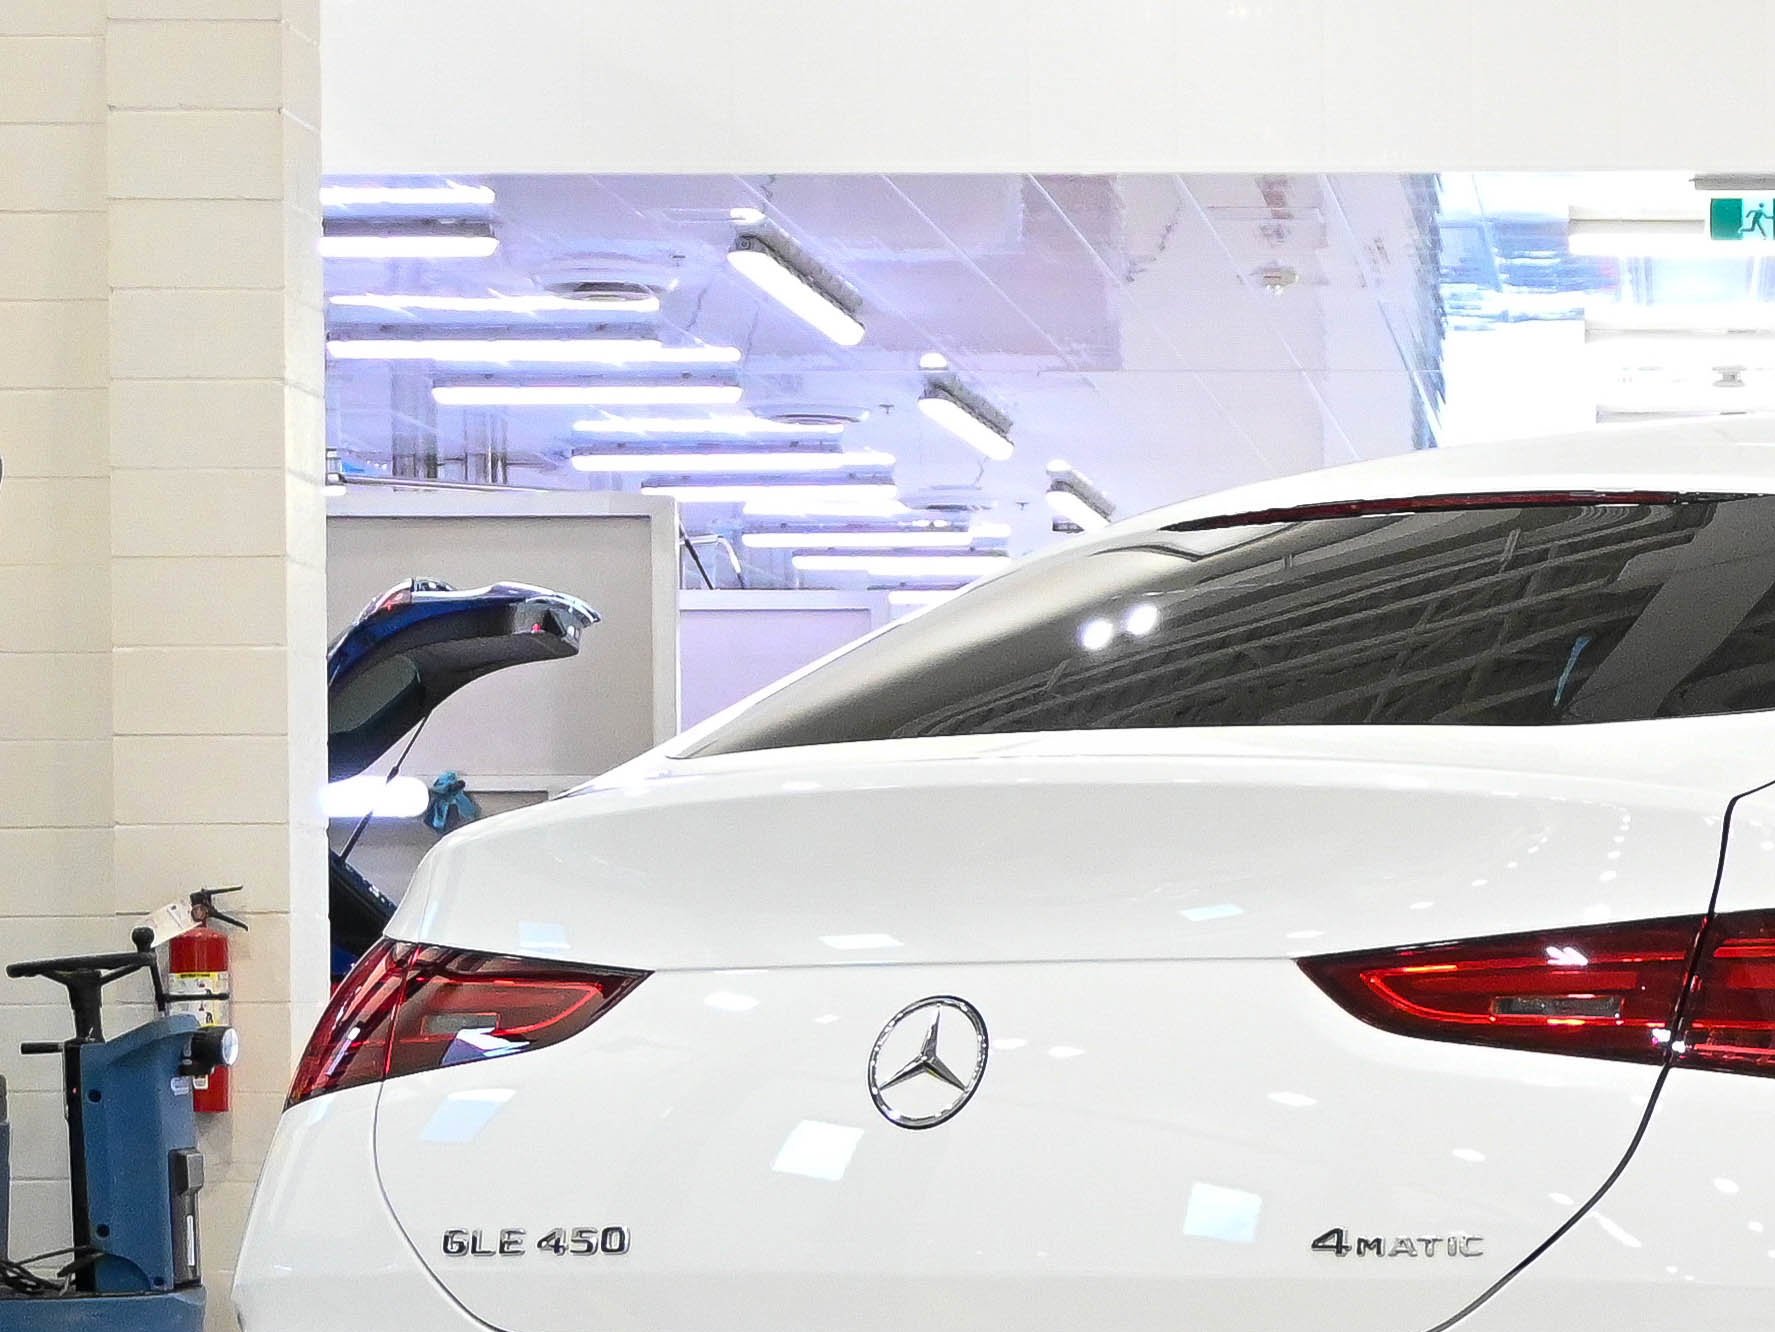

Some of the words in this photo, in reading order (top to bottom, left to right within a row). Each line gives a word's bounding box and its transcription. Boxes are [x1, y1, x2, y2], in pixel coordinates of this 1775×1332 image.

[442, 1228, 526, 1257] GLE
[537, 1225, 630, 1256] 450
[1311, 1227, 1484, 1257] 4MATIC
